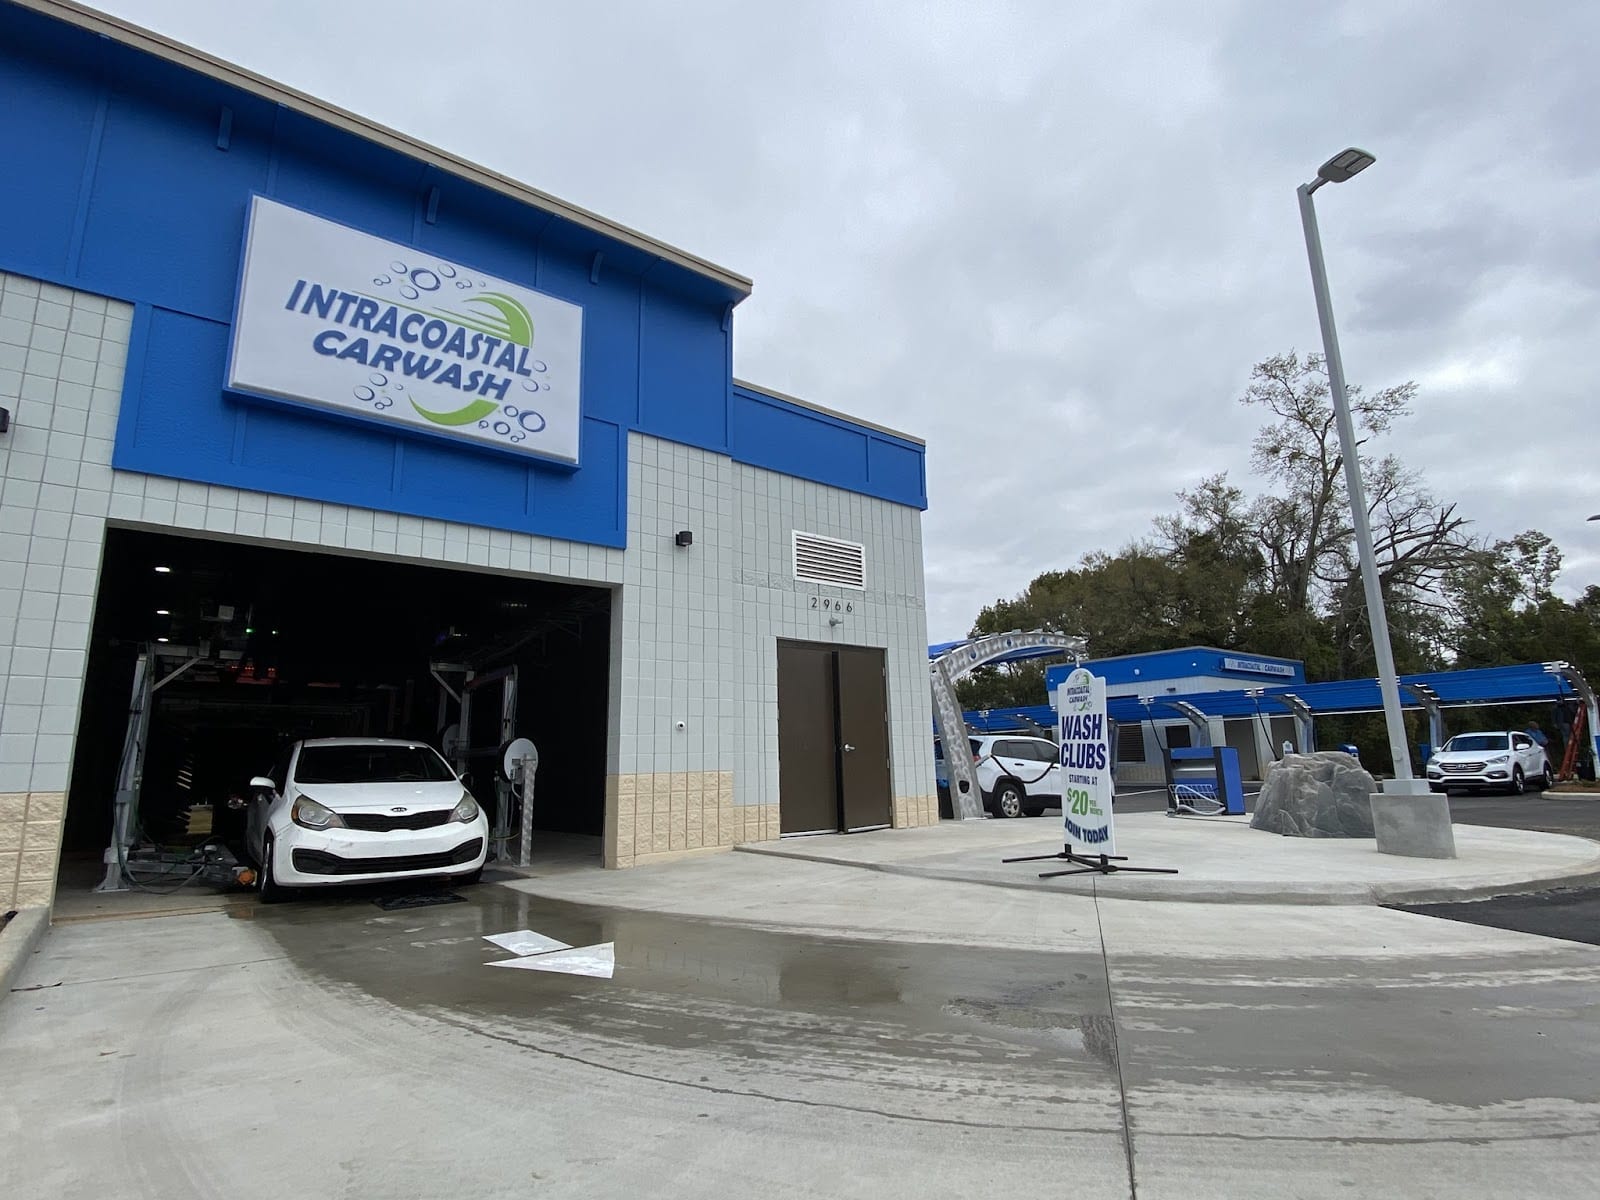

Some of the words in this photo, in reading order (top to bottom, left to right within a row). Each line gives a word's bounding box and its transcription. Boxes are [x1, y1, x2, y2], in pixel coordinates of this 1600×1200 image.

[284, 280, 532, 377] INTRACOASTAL
[312, 330, 512, 400] CARWASH
[811, 597, 853, 613] 2966
[1062, 714, 1102, 740] WASH
[1061, 742, 1106, 770] CLUBS
[1069, 774, 1090, 785] STARTING
[1091, 776, 1098, 786] AT
[1067, 786, 1089, 816] $20
[1064, 816, 1081, 841] JOIN
[1082, 824, 1109, 844] TODAY
